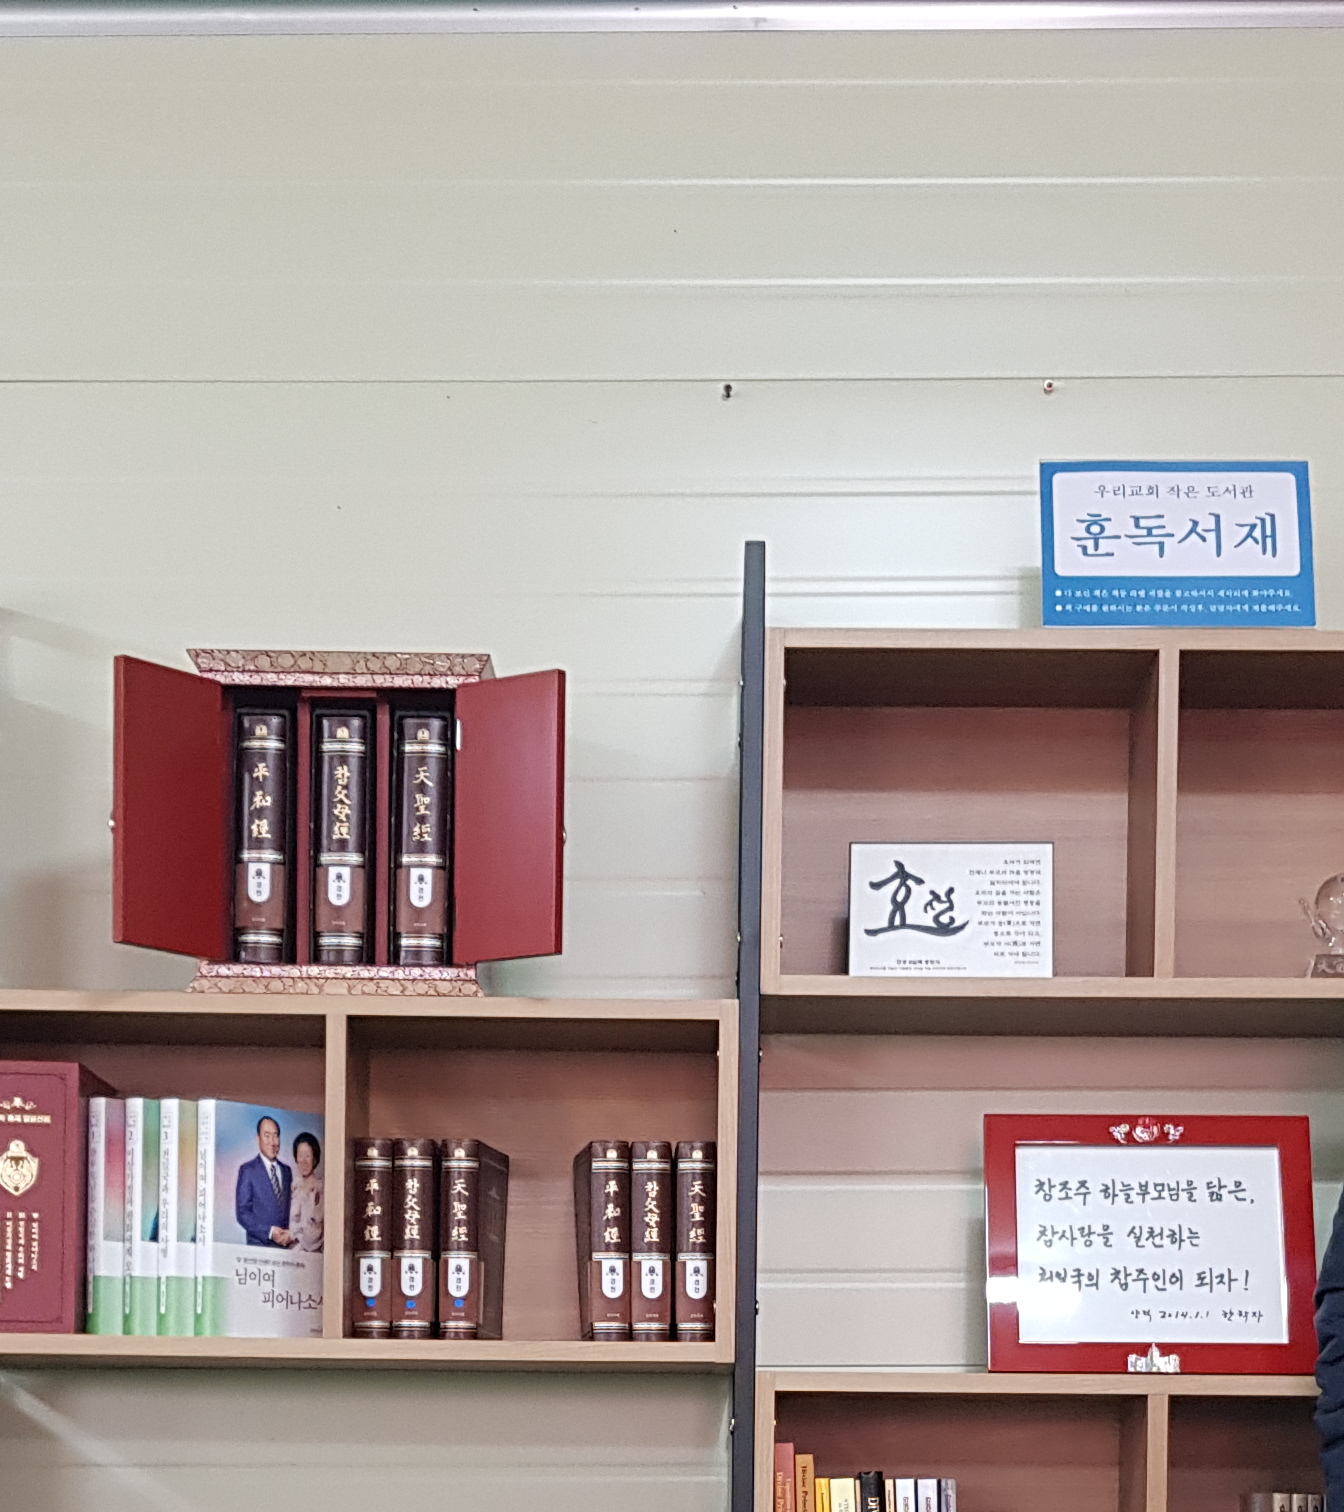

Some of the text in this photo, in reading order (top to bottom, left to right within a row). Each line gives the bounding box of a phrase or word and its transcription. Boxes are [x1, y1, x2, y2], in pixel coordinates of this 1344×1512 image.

[1094, 484, 1256, 500] 우리교회 작은 도서관
[1070, 511, 1278, 559] 훈독서재
[250, 762, 272, 840] 平和經
[411, 766, 434, 842] 天聖經
[363, 1178, 382, 1242] 平和經
[451, 1179, 469, 1243] 天聖經
[604, 1181, 622, 1244] 平和經
[688, 1180, 707, 1244] 天聖經
[1034, 1178, 1092, 1206] 창조주
[1099, 1178, 1198, 1205] 하늘부모님을
[1036, 1223, 1201, 1251] 참사랑을 실천하는
[236, 1267, 275, 1288] 님이여
[1110, 1267, 1184, 1293] 참주인이
